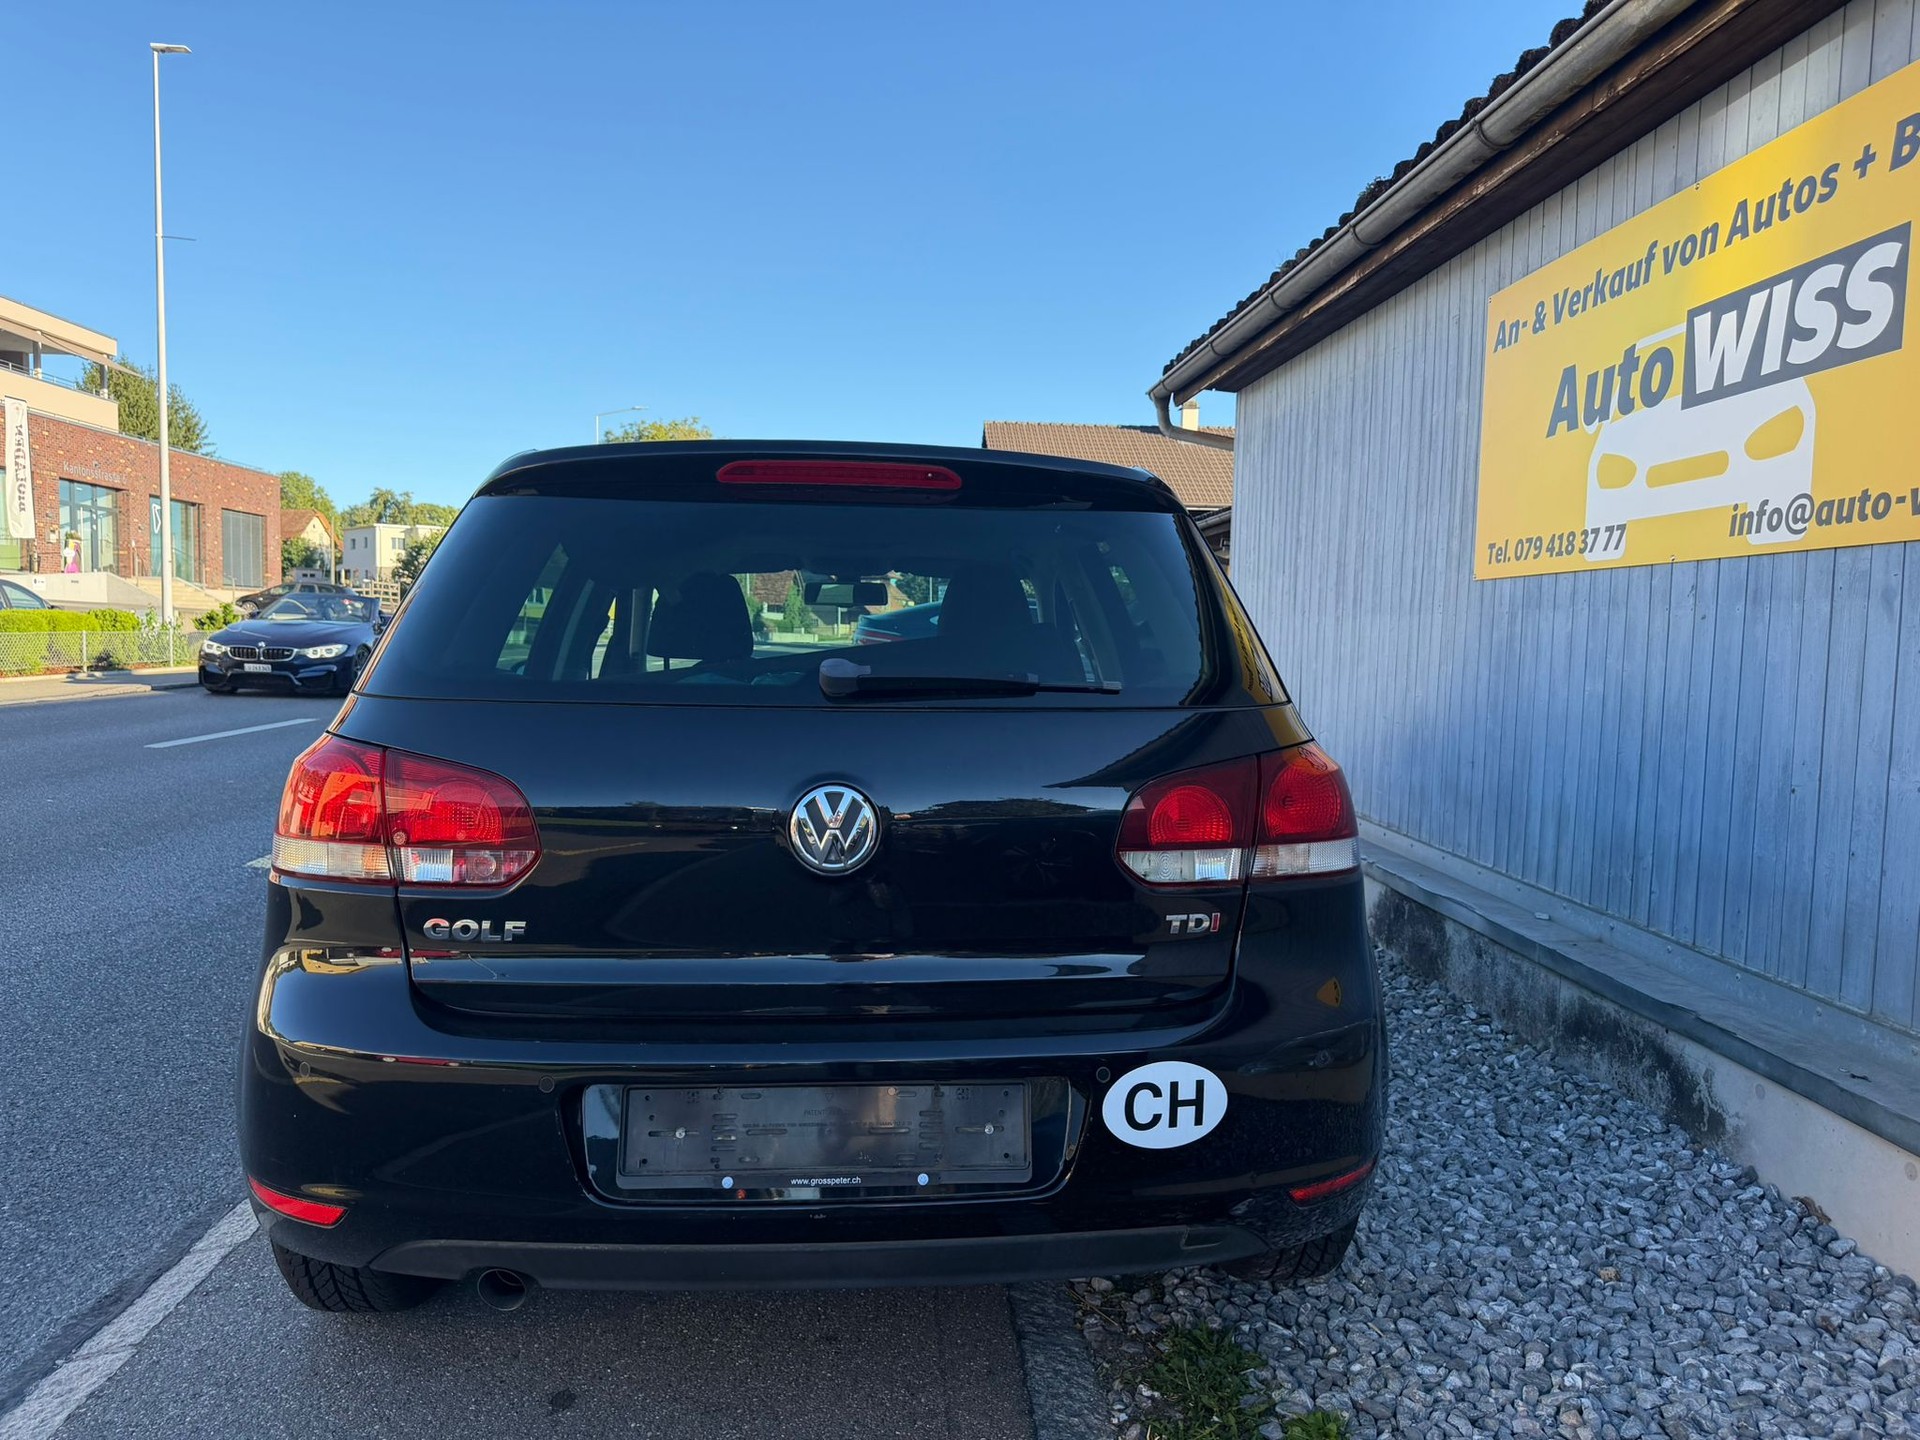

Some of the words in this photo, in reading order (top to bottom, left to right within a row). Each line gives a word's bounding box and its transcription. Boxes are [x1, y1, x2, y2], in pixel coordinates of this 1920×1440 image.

[1493, 319, 1528, 353] An-
[1532, 301, 1547, 334] &
[1553, 240, 1659, 325] Verkauf
[1662, 222, 1720, 275] von
[1724, 162, 1841, 248] Autos
[1852, 143, 1877, 180] +
[1546, 342, 1674, 439] Auto
[1694, 241, 1903, 395] WISS
[1487, 539, 1511, 565] Tel.
[1514, 536, 1543, 561] 079
[1545, 531, 1576, 557] 418
[1578, 527, 1601, 554] 37
[1602, 523, 1627, 551] 77
[423, 918, 526, 941] GOLF
[1166, 912, 1220, 934] TDI
[1124, 1079, 1204, 1131] CH
[790, 1176, 862, 1187] www.grosspeter.ch
